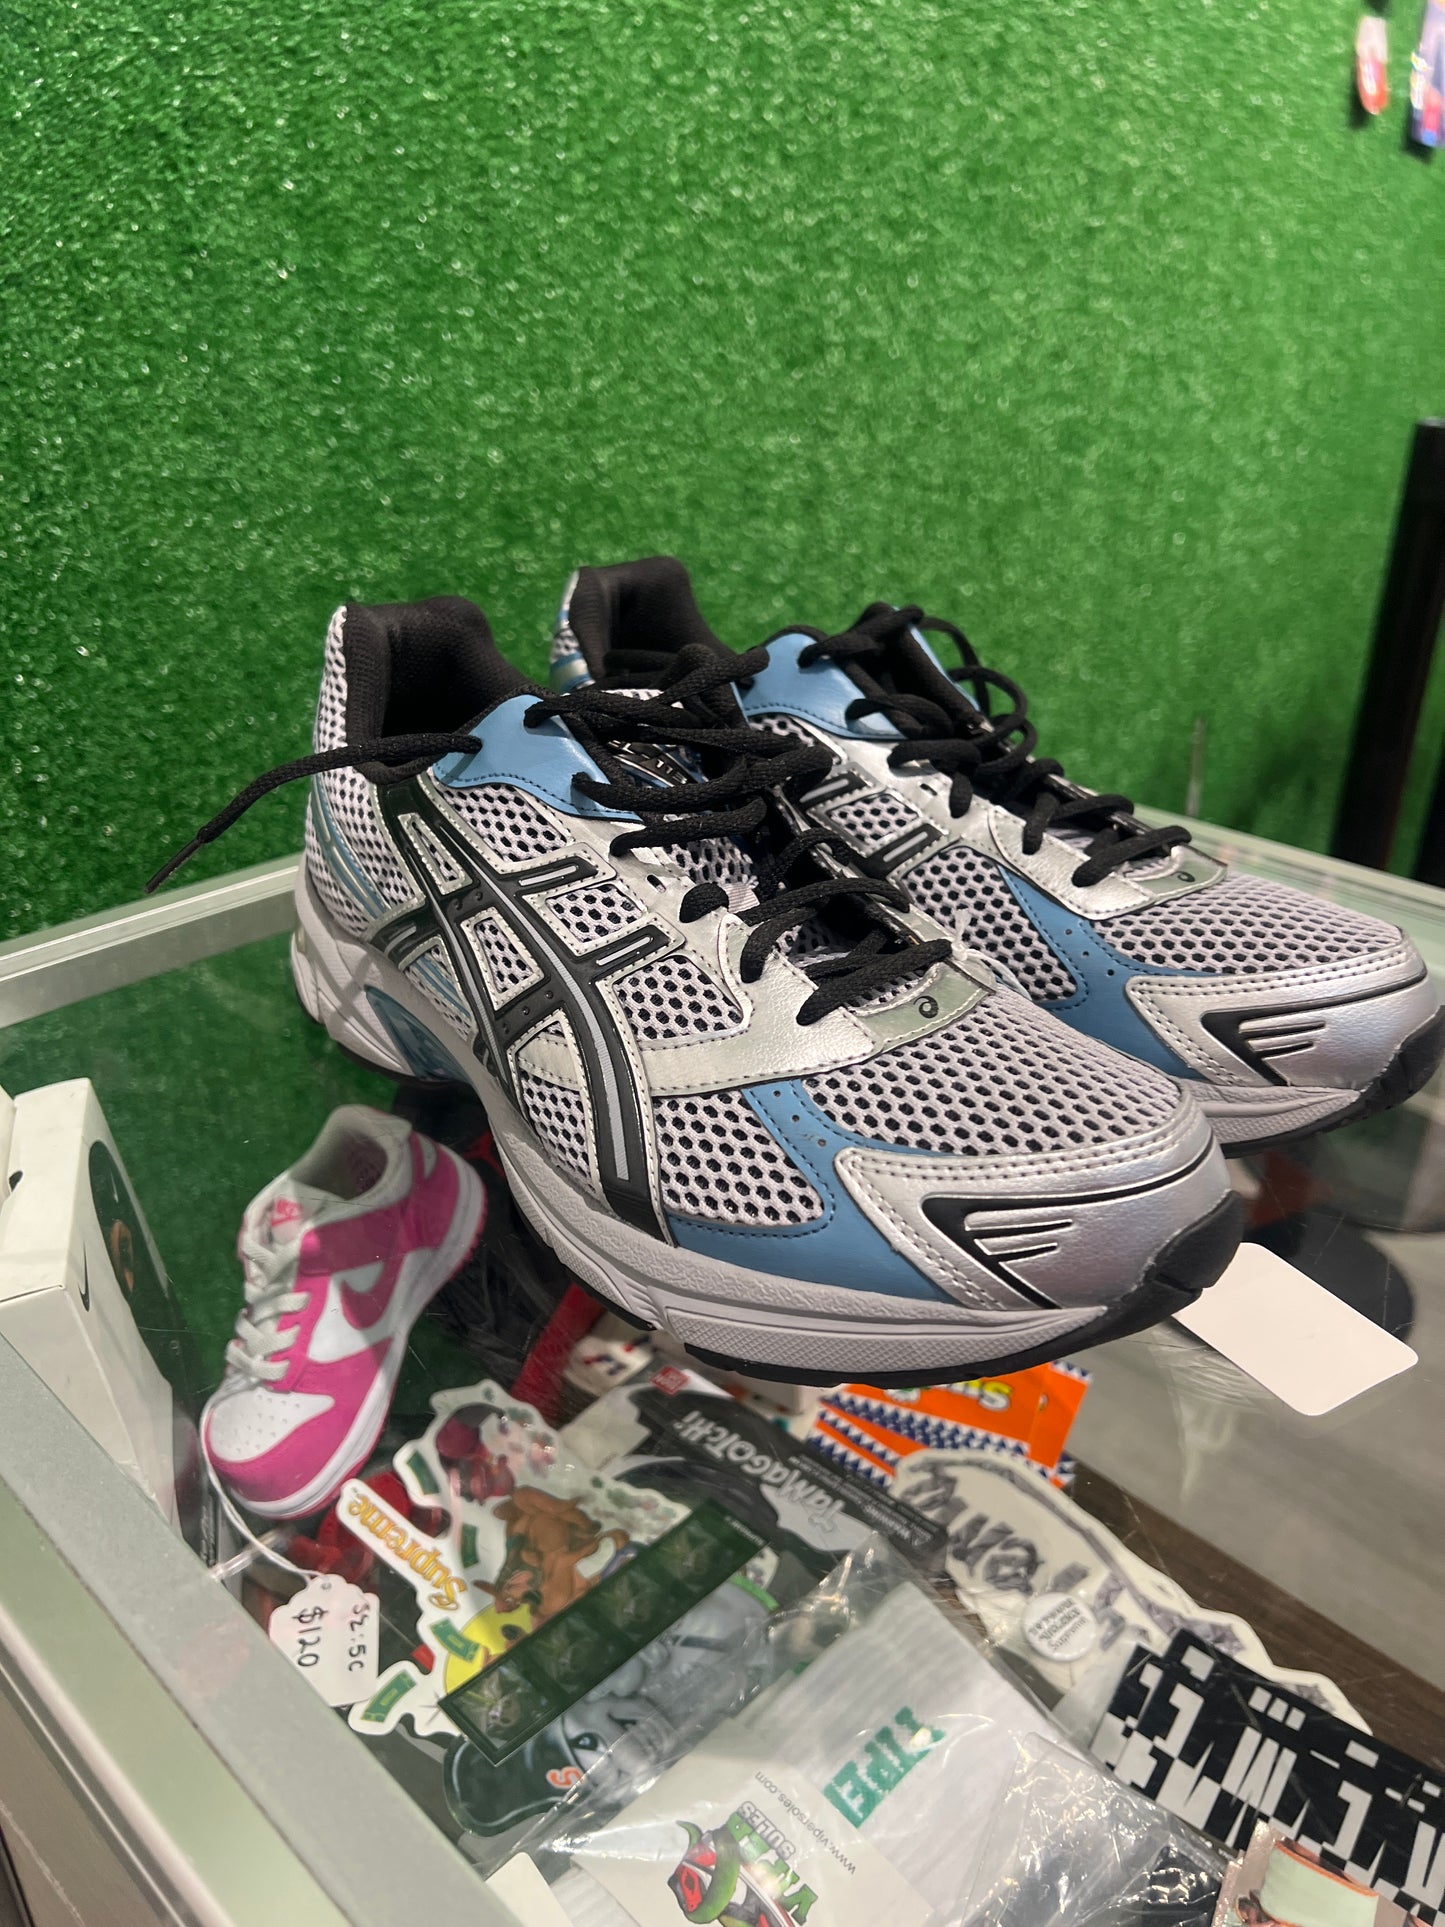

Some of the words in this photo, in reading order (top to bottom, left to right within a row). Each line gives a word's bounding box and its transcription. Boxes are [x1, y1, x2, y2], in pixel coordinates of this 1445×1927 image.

[348, 1494, 468, 1611] Supreme
[291, 1605, 330, 1668] $120
[726, 1811, 819, 1927] VIPER
[737, 1800, 797, 1862] SOLES
[754, 1770, 857, 1876] www.vipersoles.com
